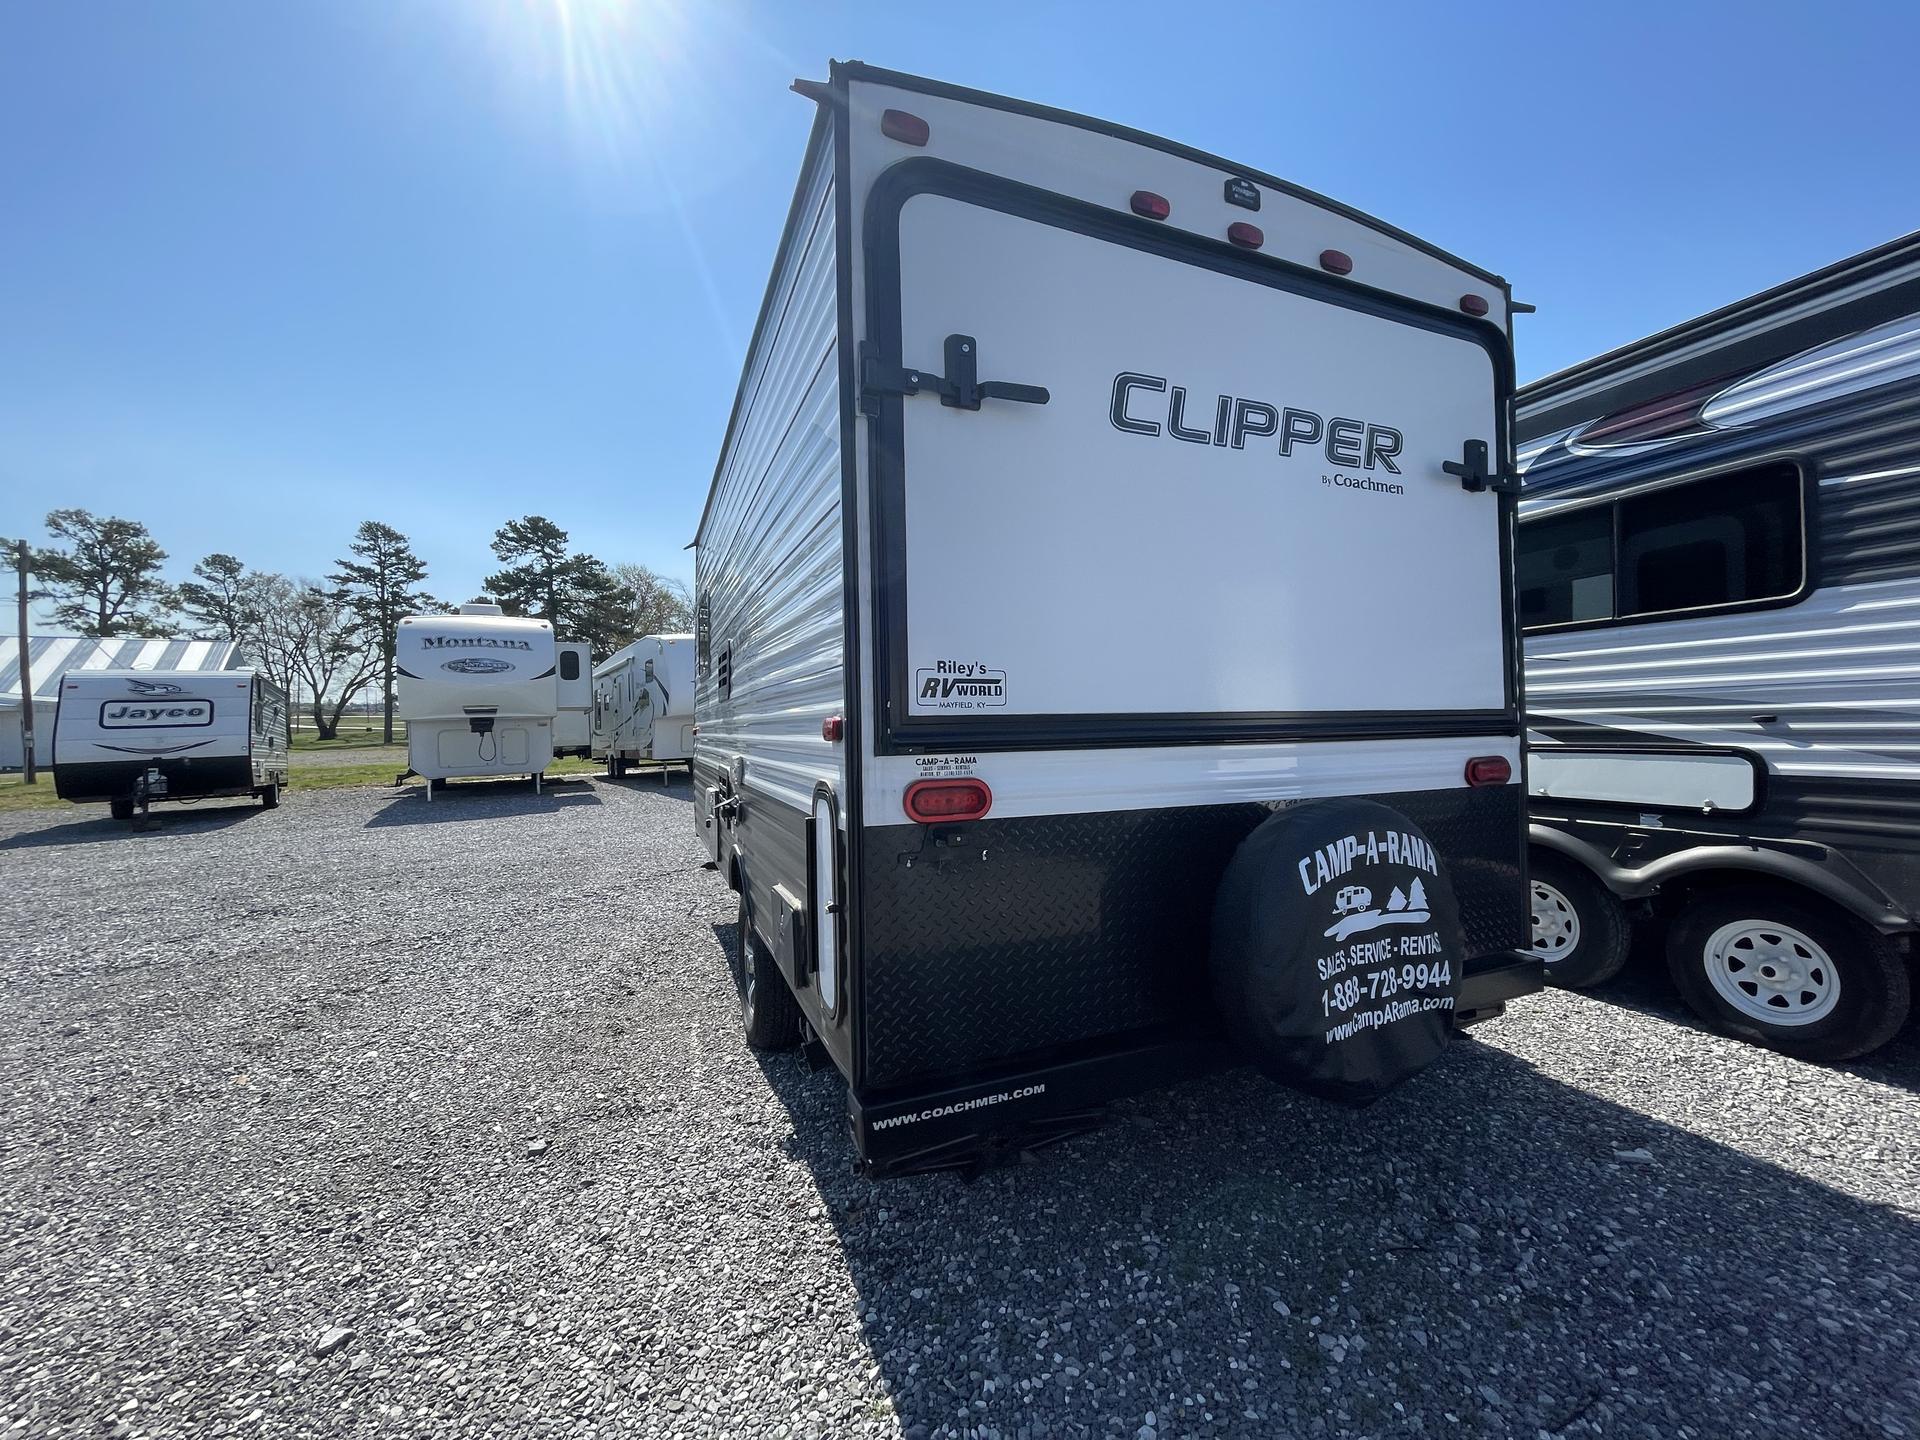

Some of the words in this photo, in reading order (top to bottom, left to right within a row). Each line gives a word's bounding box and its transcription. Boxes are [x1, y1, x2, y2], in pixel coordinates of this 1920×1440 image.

[1109, 371, 1404, 475] CLIPPER
[1322, 475, 1331, 487] By
[1333, 473, 1404, 495] Coachmen
[420, 636, 533, 651] Montana
[936, 660, 987, 677] Riley's
[920, 677, 958, 698] RV
[956, 685, 1002, 697] WORLD
[107, 705, 206, 721] Jayco
[938, 701, 975, 709] MAYFIELD,
[977, 701, 986, 709] KY
[915, 756, 977, 766] CAMP-A-RAMA
[1299, 831, 1438, 896] CAMP-A-RAMA
[1317, 949, 1347, 981] SALES
[1350, 938, 1392, 966] SERVICE
[1322, 960, 1451, 1017] 1-888-728-9944
[1326, 996, 1454, 1045] www.CampARama.com
[872, 1084, 1046, 1131] WWW.COACHMEN.COM
